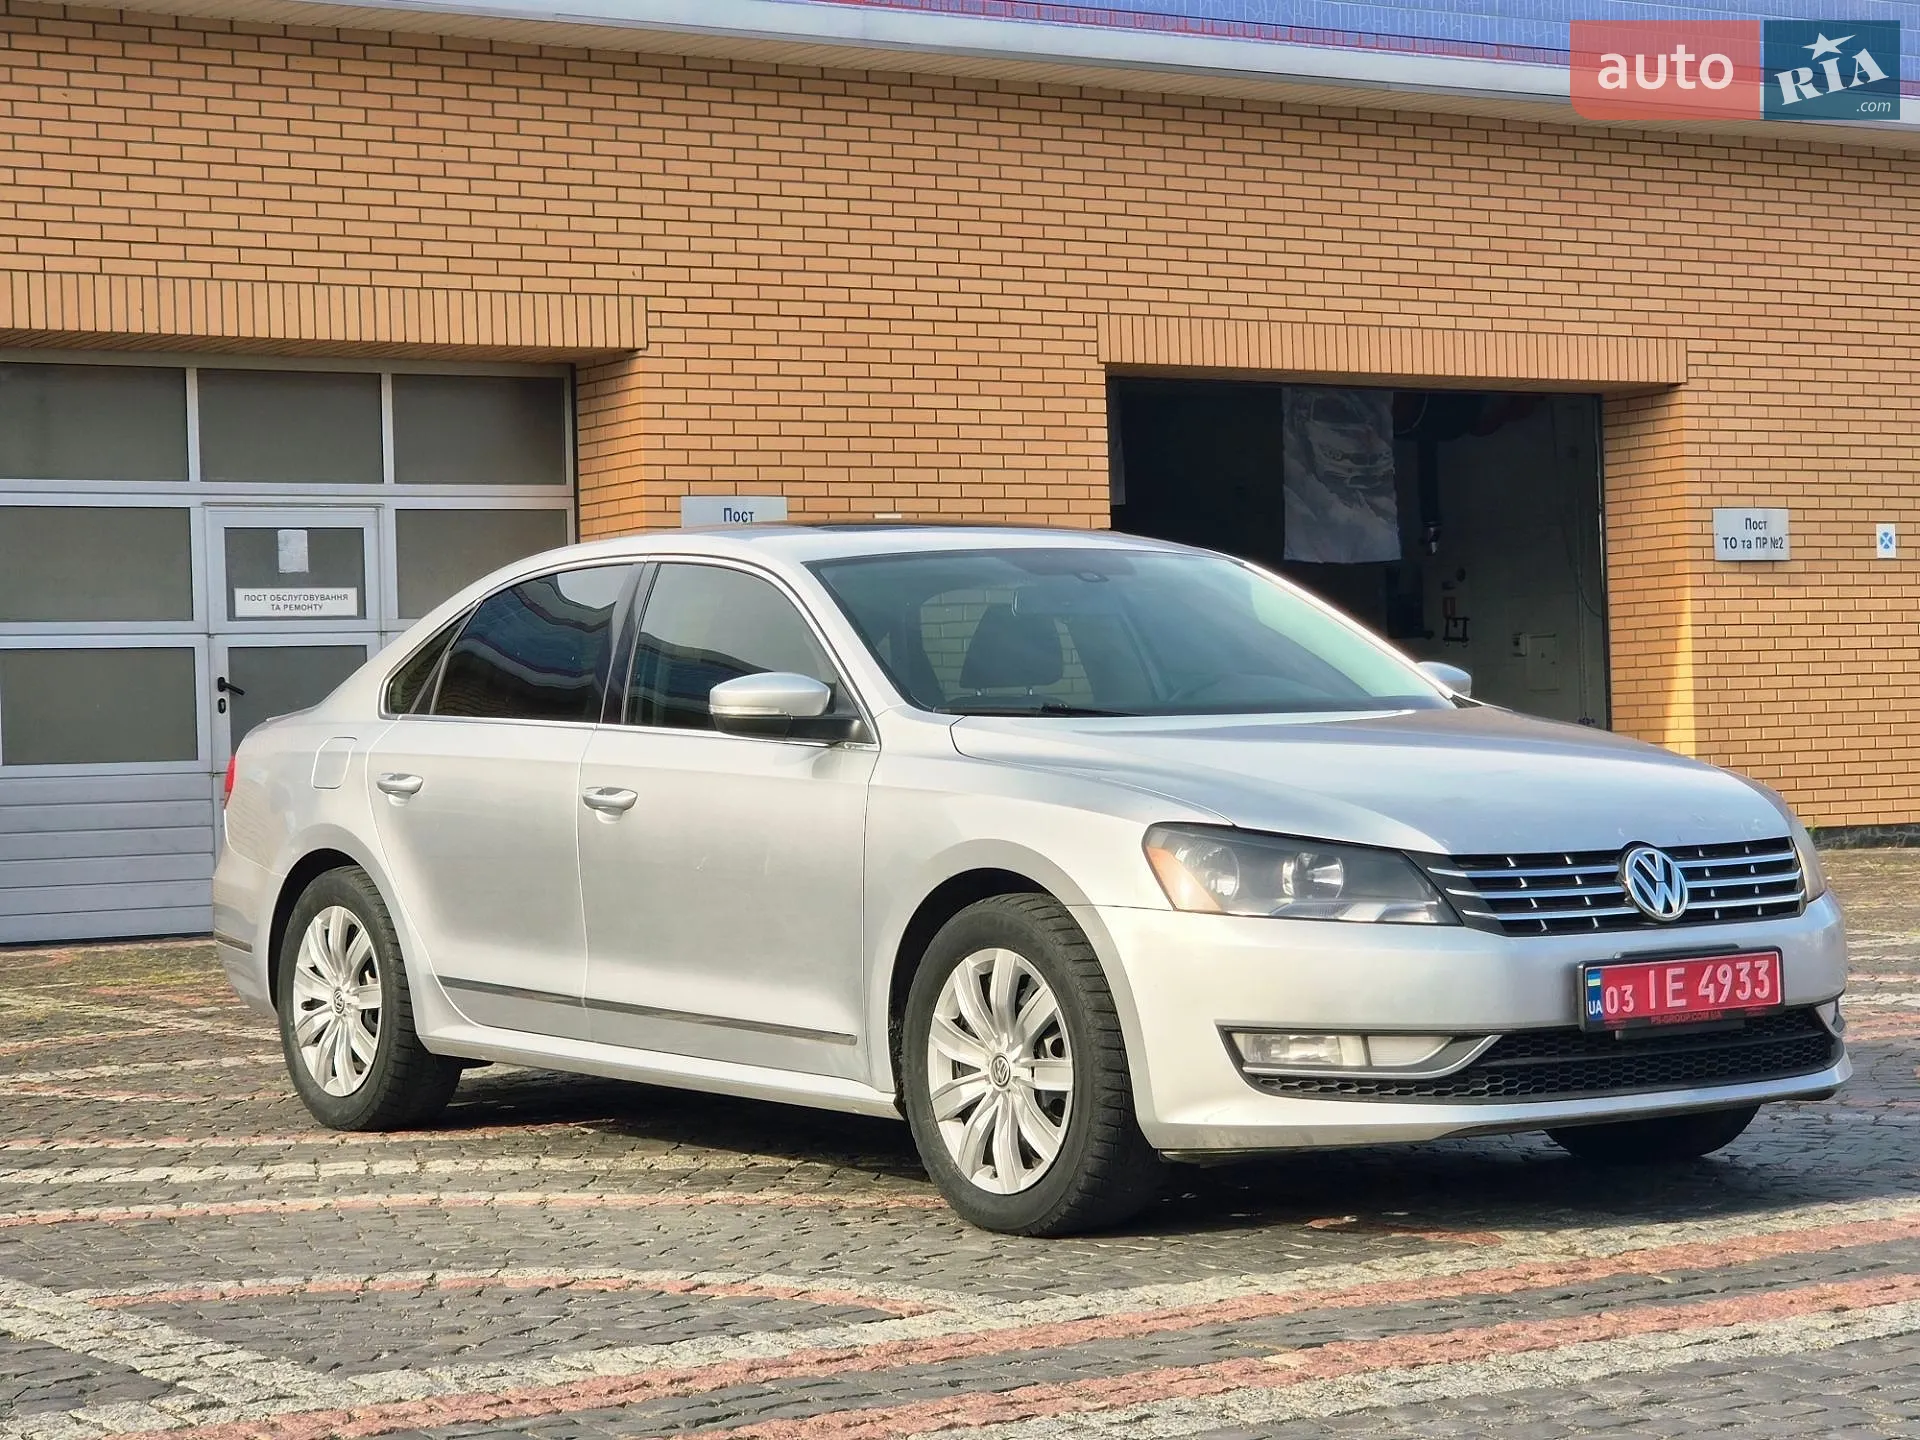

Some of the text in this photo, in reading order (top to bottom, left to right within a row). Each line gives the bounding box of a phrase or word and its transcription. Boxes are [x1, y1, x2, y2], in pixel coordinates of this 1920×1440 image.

[723, 507, 755, 523] Пост
[1744, 517, 1768, 531] Пост
[1723, 536, 1784, 550] ТО та ПР №2
[244, 594, 349, 602] ПОСТ ОБСЛУГОВУВАННЯ
[271, 603, 323, 611] ТА РЕМОНТУ
[1588, 960, 1770, 1015] UA 03 IE 4933
